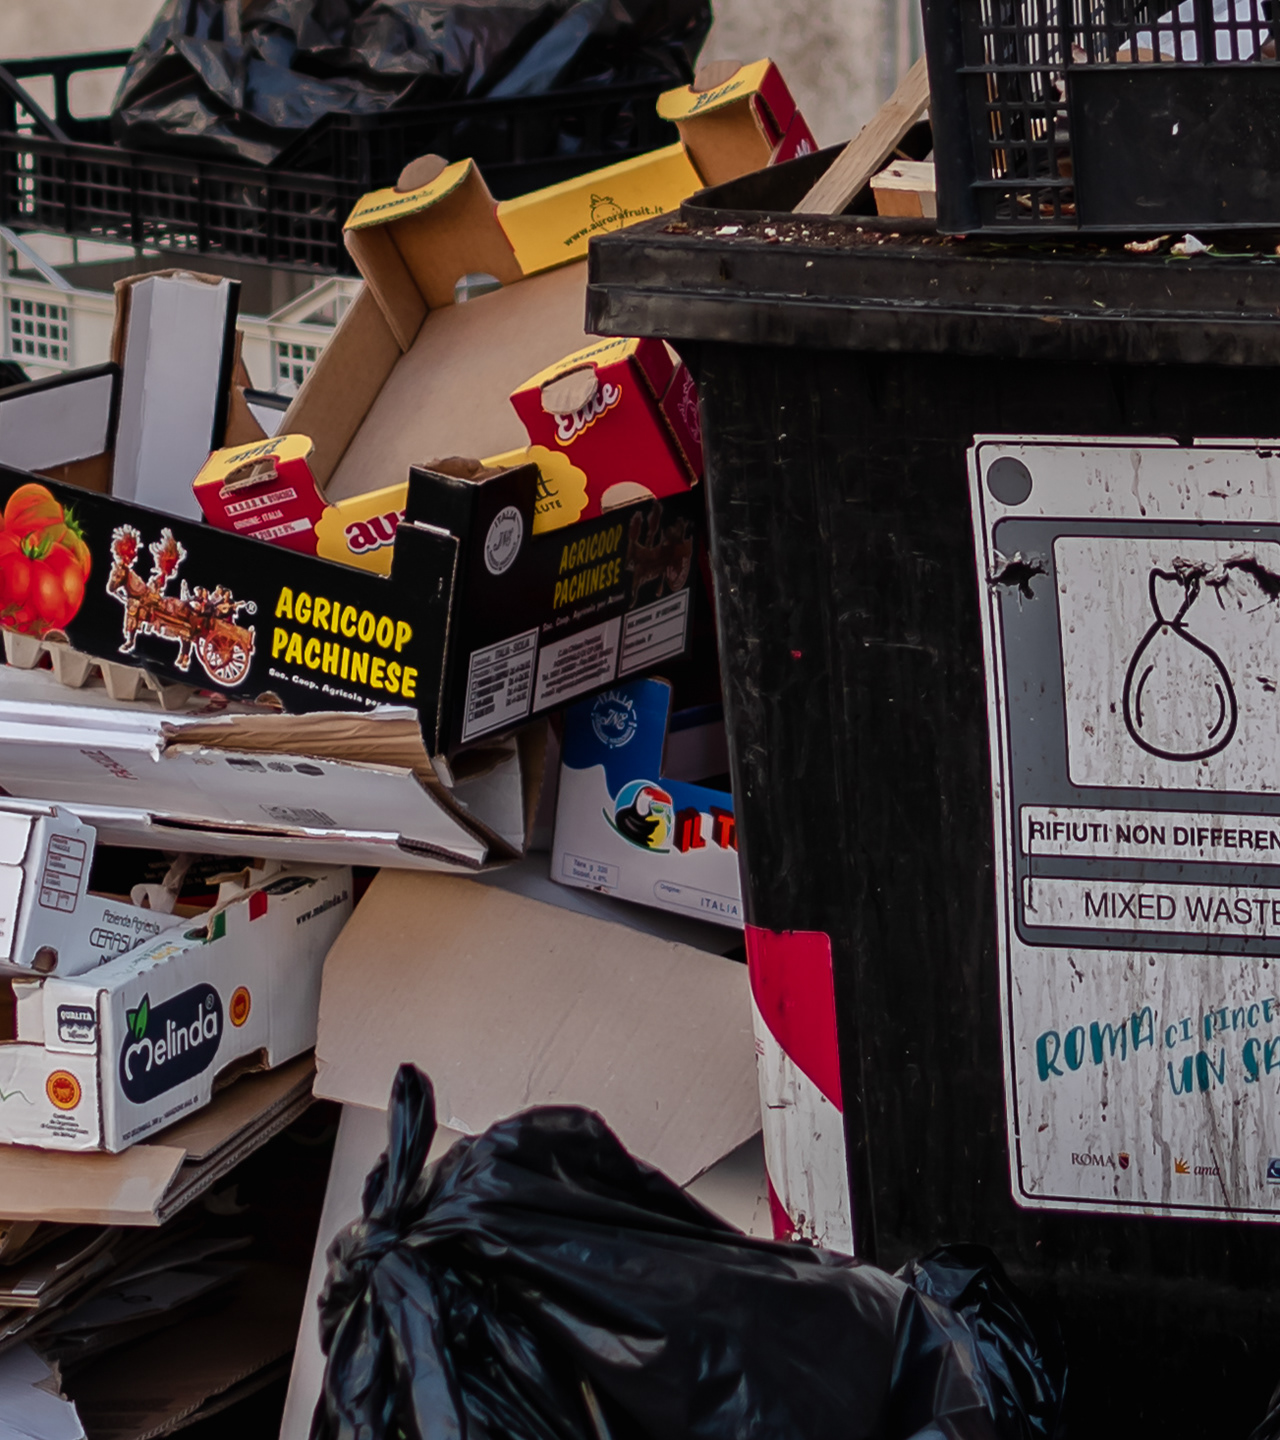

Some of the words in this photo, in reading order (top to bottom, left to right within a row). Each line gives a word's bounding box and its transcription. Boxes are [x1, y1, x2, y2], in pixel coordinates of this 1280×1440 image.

[558, 523, 624, 576] AGRICOOP
[552, 556, 622, 610] PACHINESE
[274, 585, 413, 653] AGRICOOP
[270, 626, 419, 698] PACHINESE
[291, 674, 320, 693] Coop.
[321, 682, 364, 704] Agricola
[596, 691, 634, 710] ITALIA
[1030, 820, 1109, 844] RIFIUTI
[1116, 824, 1166, 846] NON
[700, 897, 738, 916] ITALIA
[1083, 891, 1177, 921] MIXED
[124, 1002, 218, 1082] Melinda
[1167, 1045, 1226, 1096] UN
[1071, 1152, 1114, 1170] ROMA
[1193, 1165, 1220, 1177] ama
